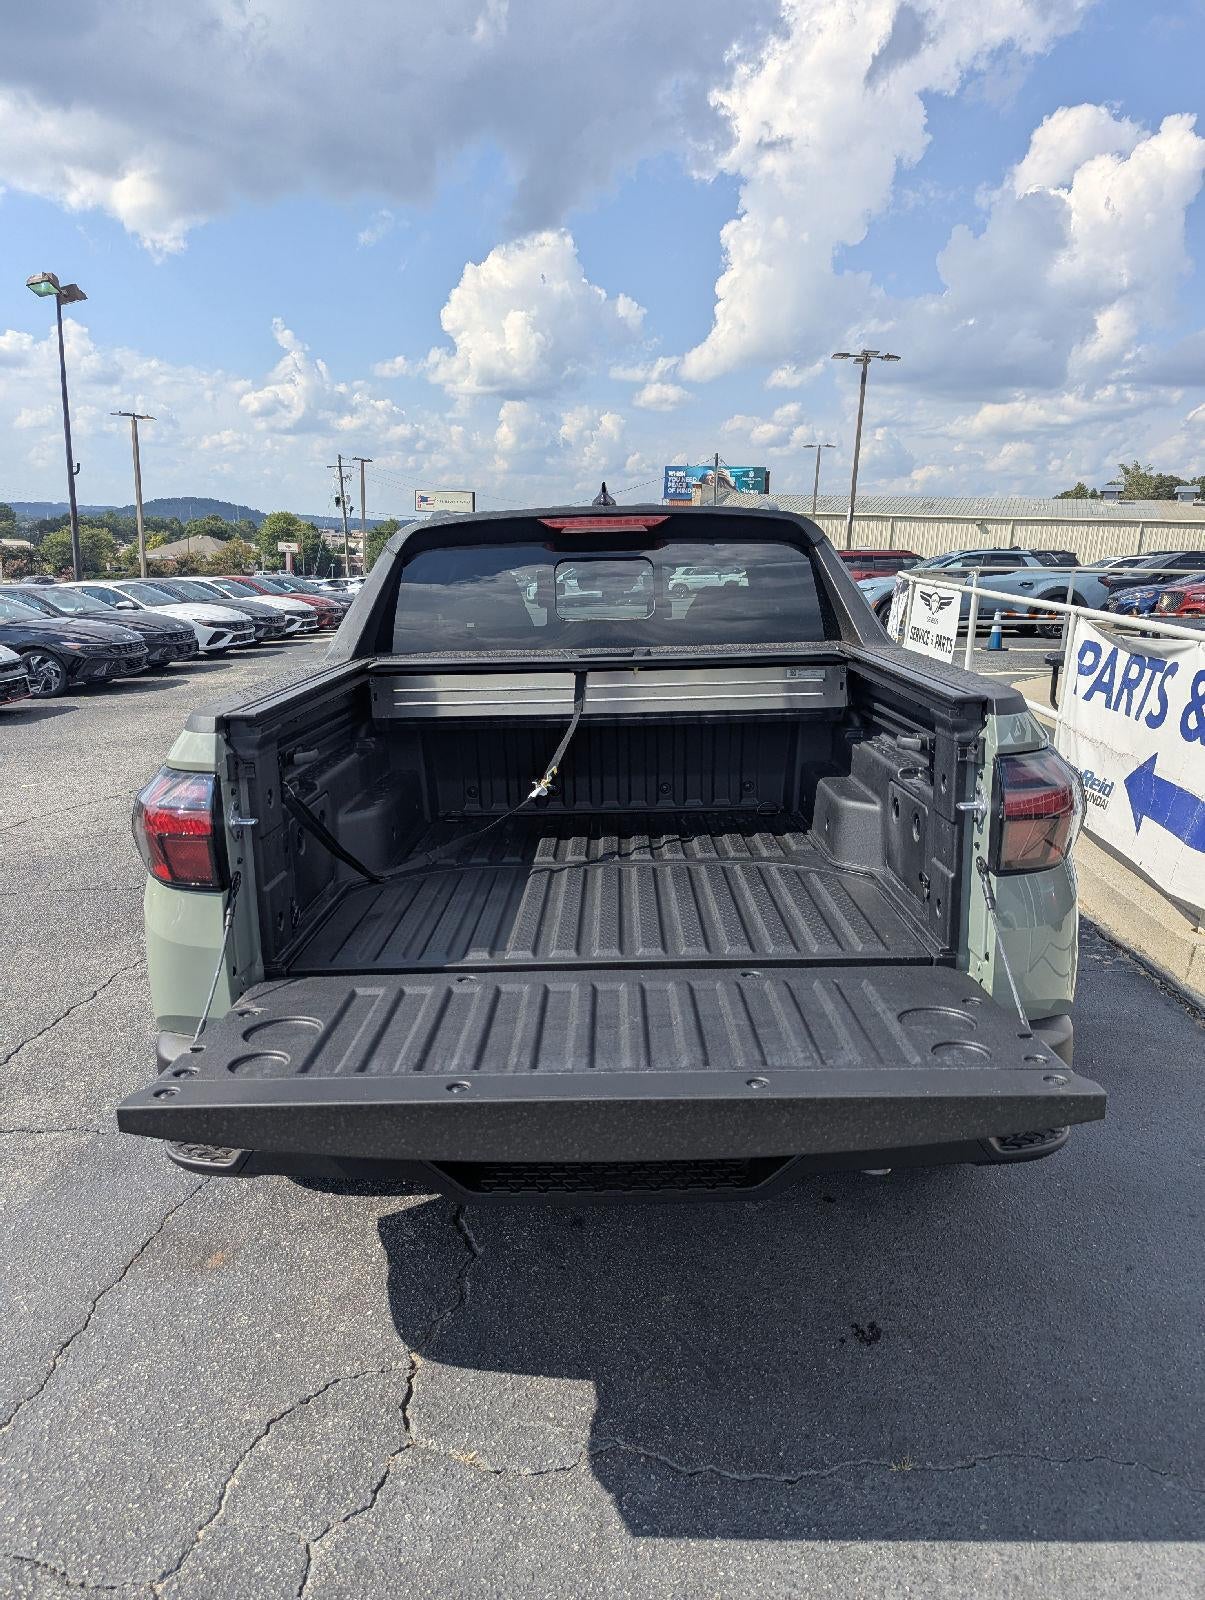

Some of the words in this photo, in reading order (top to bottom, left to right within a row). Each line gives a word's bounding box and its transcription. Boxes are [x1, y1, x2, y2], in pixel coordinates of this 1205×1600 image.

[910, 626, 930, 646] SERVICE
[934, 634, 954, 654] PARTS
[1073, 640, 1179, 729] PARTS
[1180, 669, 1205, 746] &
[1082, 770, 1115, 797] Reid
[1085, 790, 1109, 810] UNDAI
